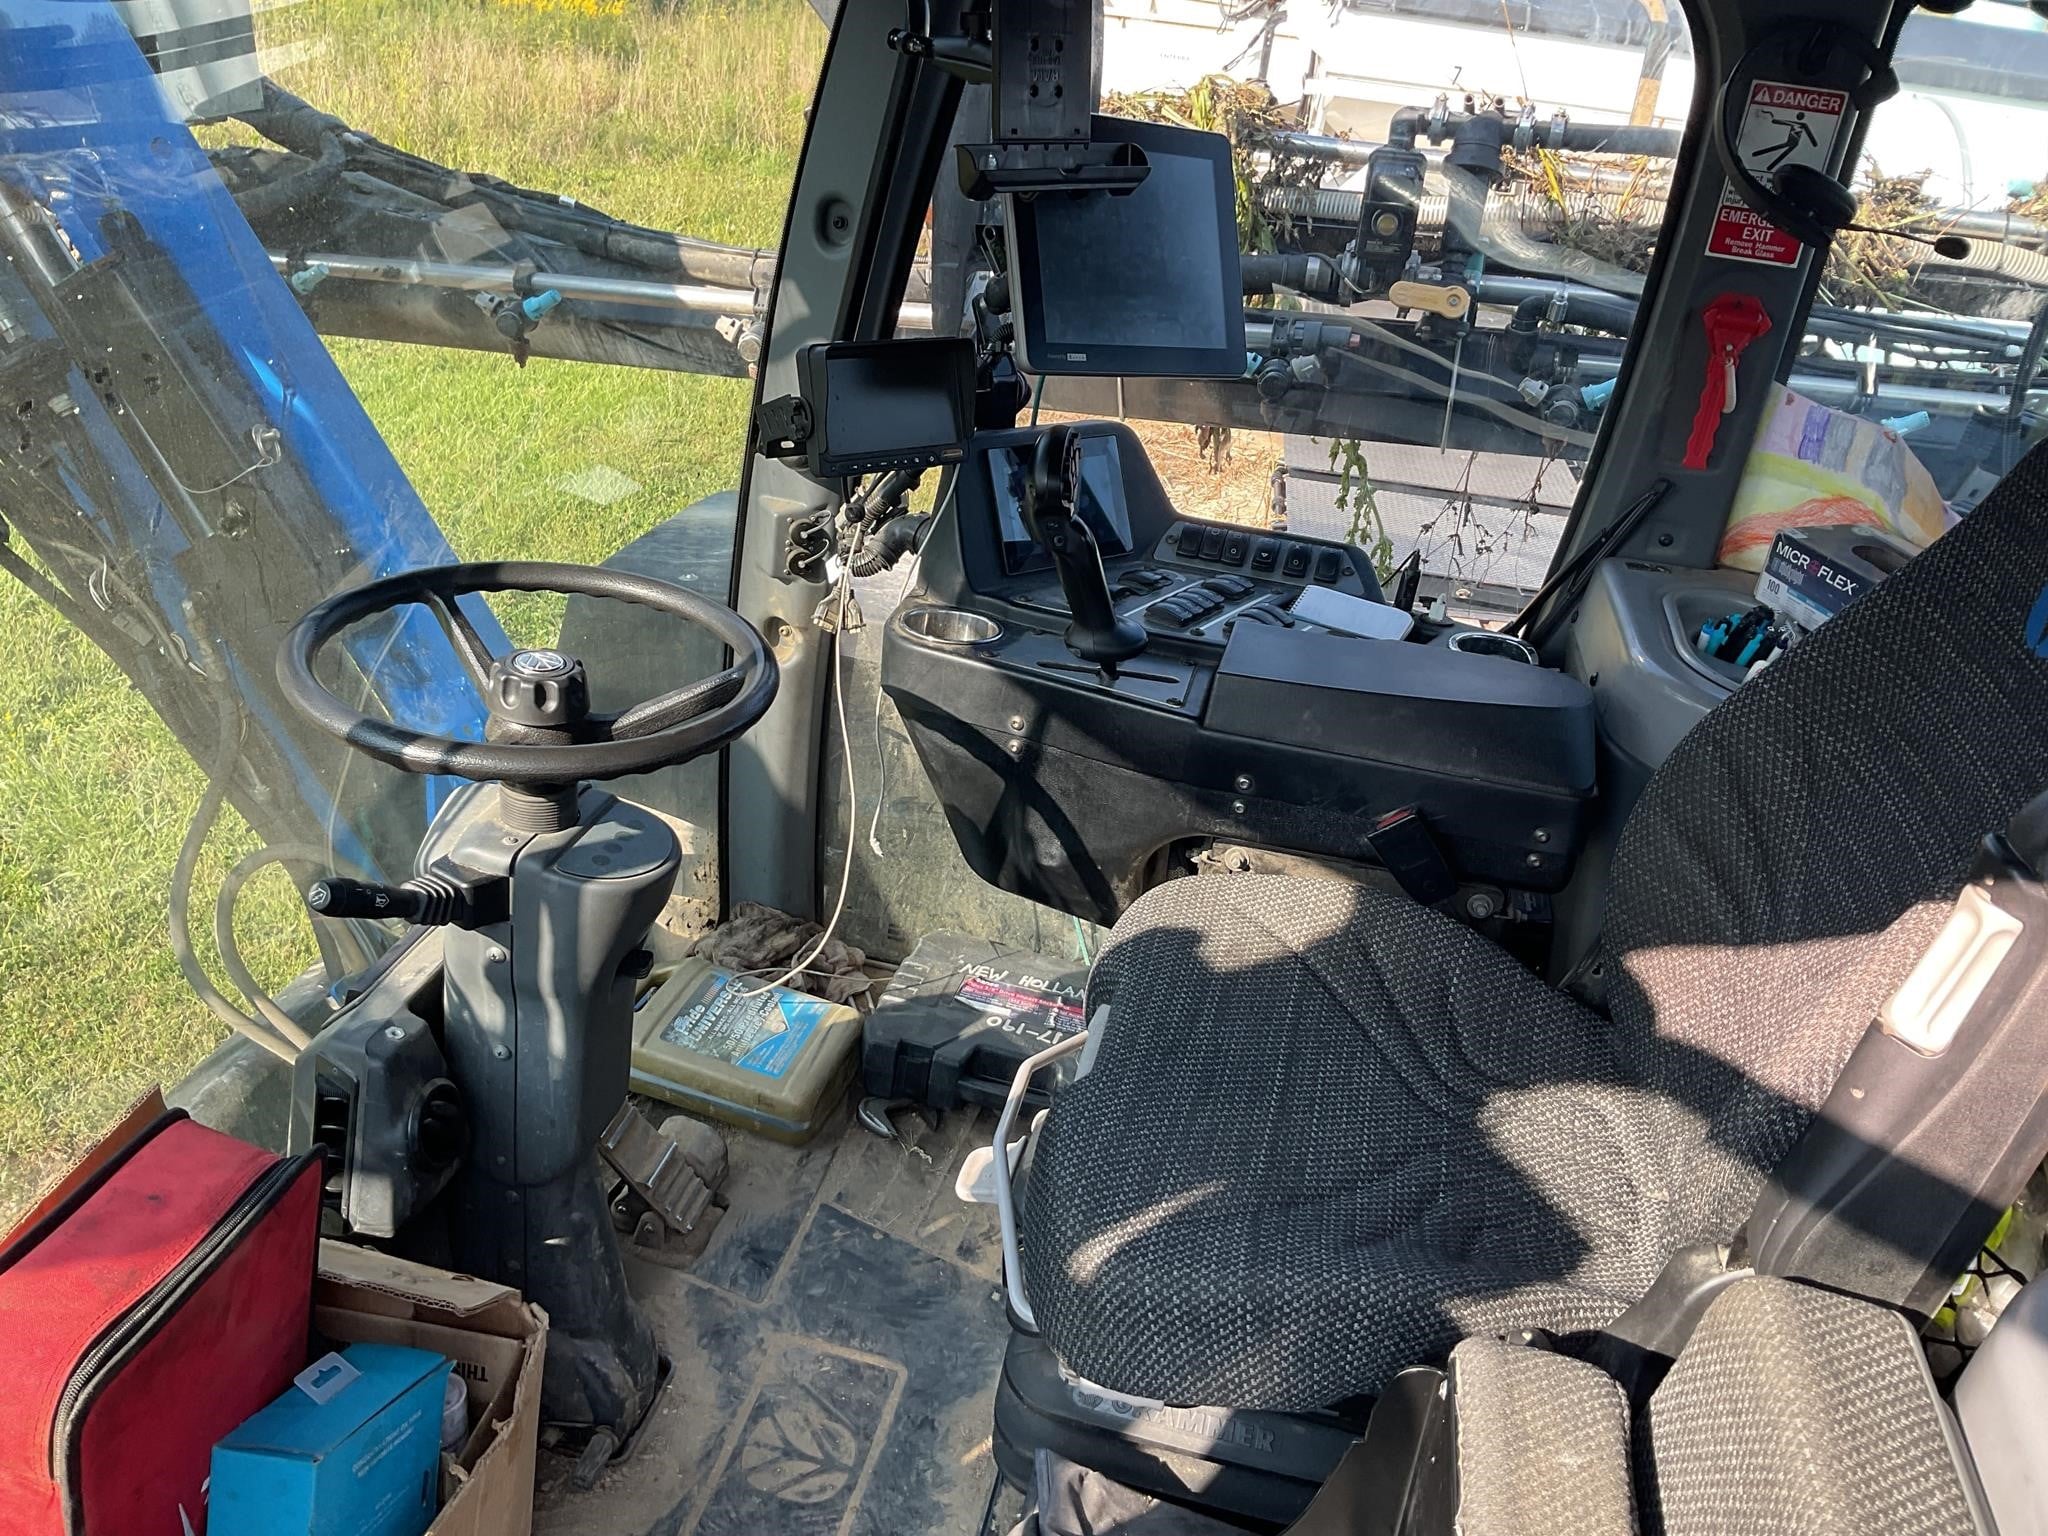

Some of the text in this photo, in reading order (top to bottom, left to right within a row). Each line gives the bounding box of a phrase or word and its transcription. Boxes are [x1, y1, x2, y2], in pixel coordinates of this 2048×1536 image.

[1773, 91, 1841, 111] DANGER
[1742, 227, 1775, 243] EXIT
[1724, 237, 1786, 253] Remove Hammer
[1731, 245, 1775, 258] Break Glass
[1766, 577, 1780, 594] 100
[958, 963, 1009, 982] NEW
[723, 1027, 745, 1050] 50/50
